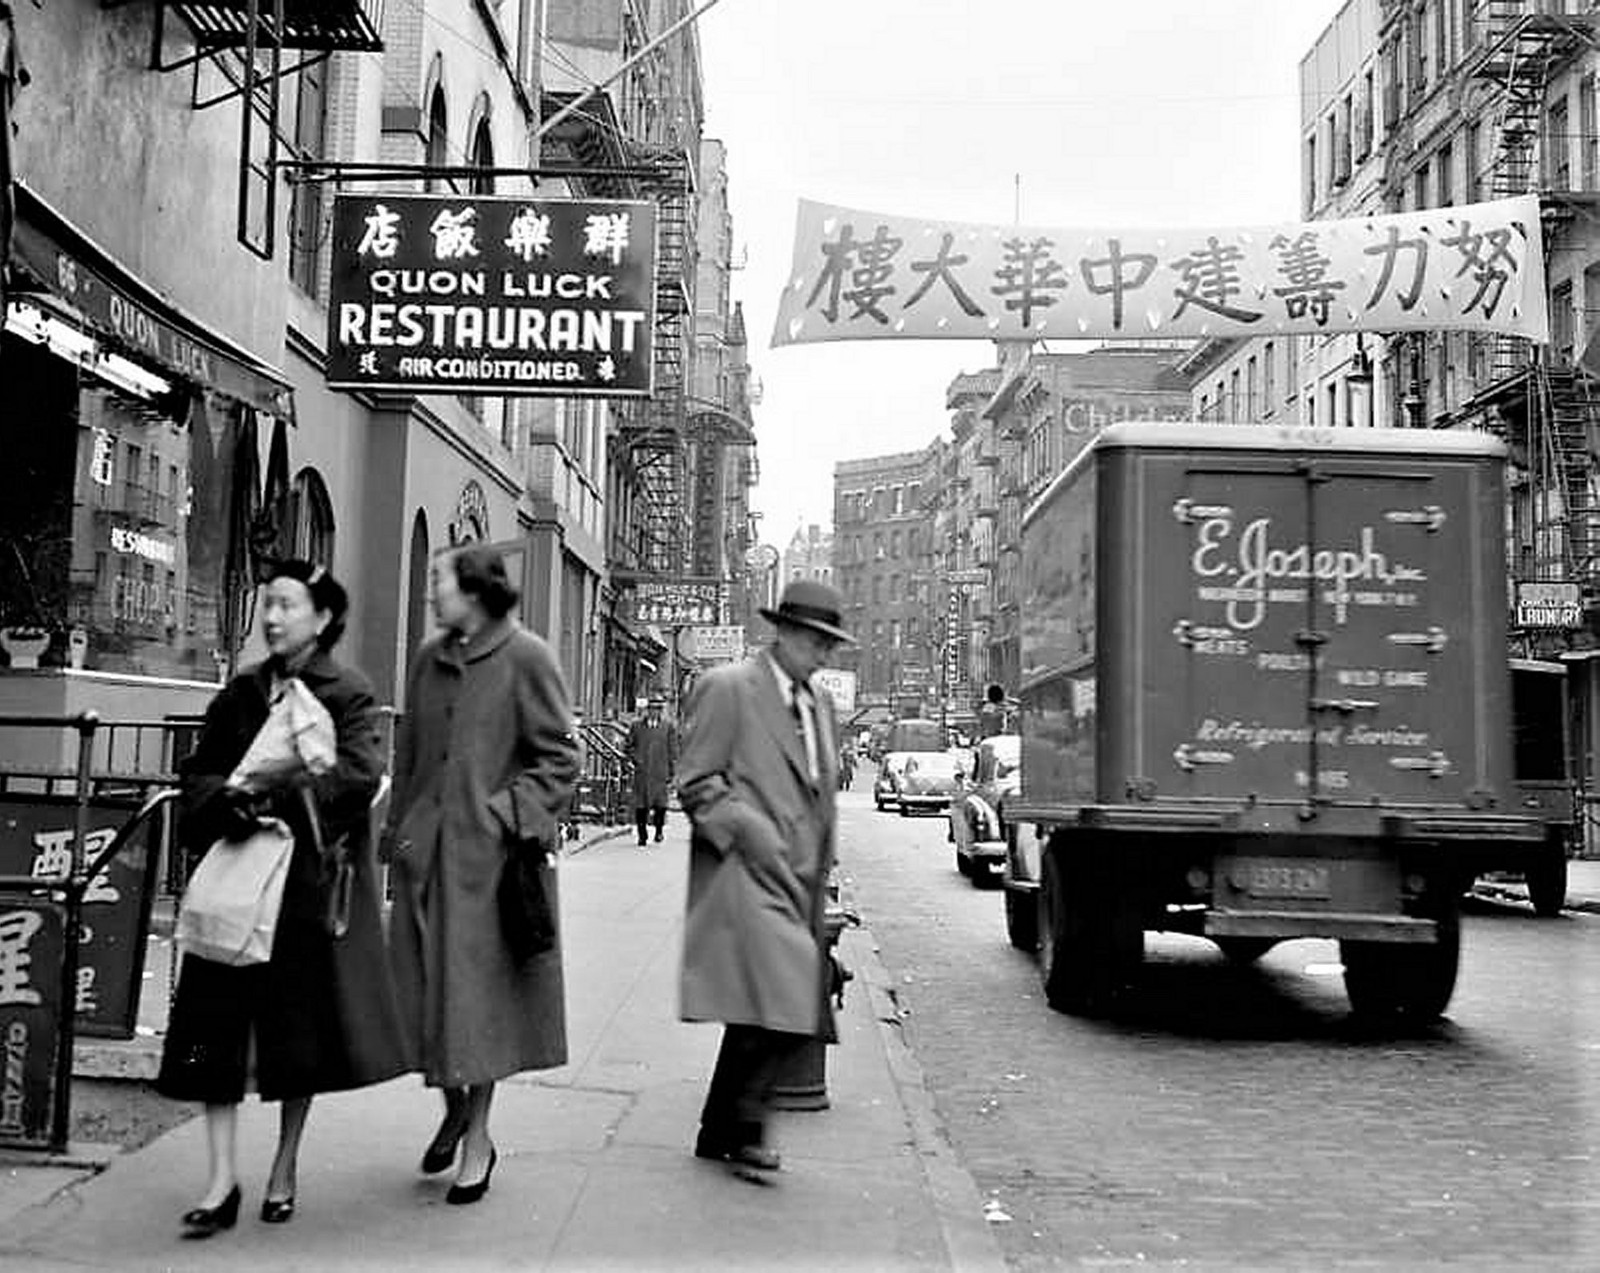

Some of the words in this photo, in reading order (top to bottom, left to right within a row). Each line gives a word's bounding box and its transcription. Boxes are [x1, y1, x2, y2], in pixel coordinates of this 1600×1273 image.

[370, 270, 484, 297] QUON
[504, 273, 612, 300] LUCK
[339, 303, 645, 351] RESTAURANT
